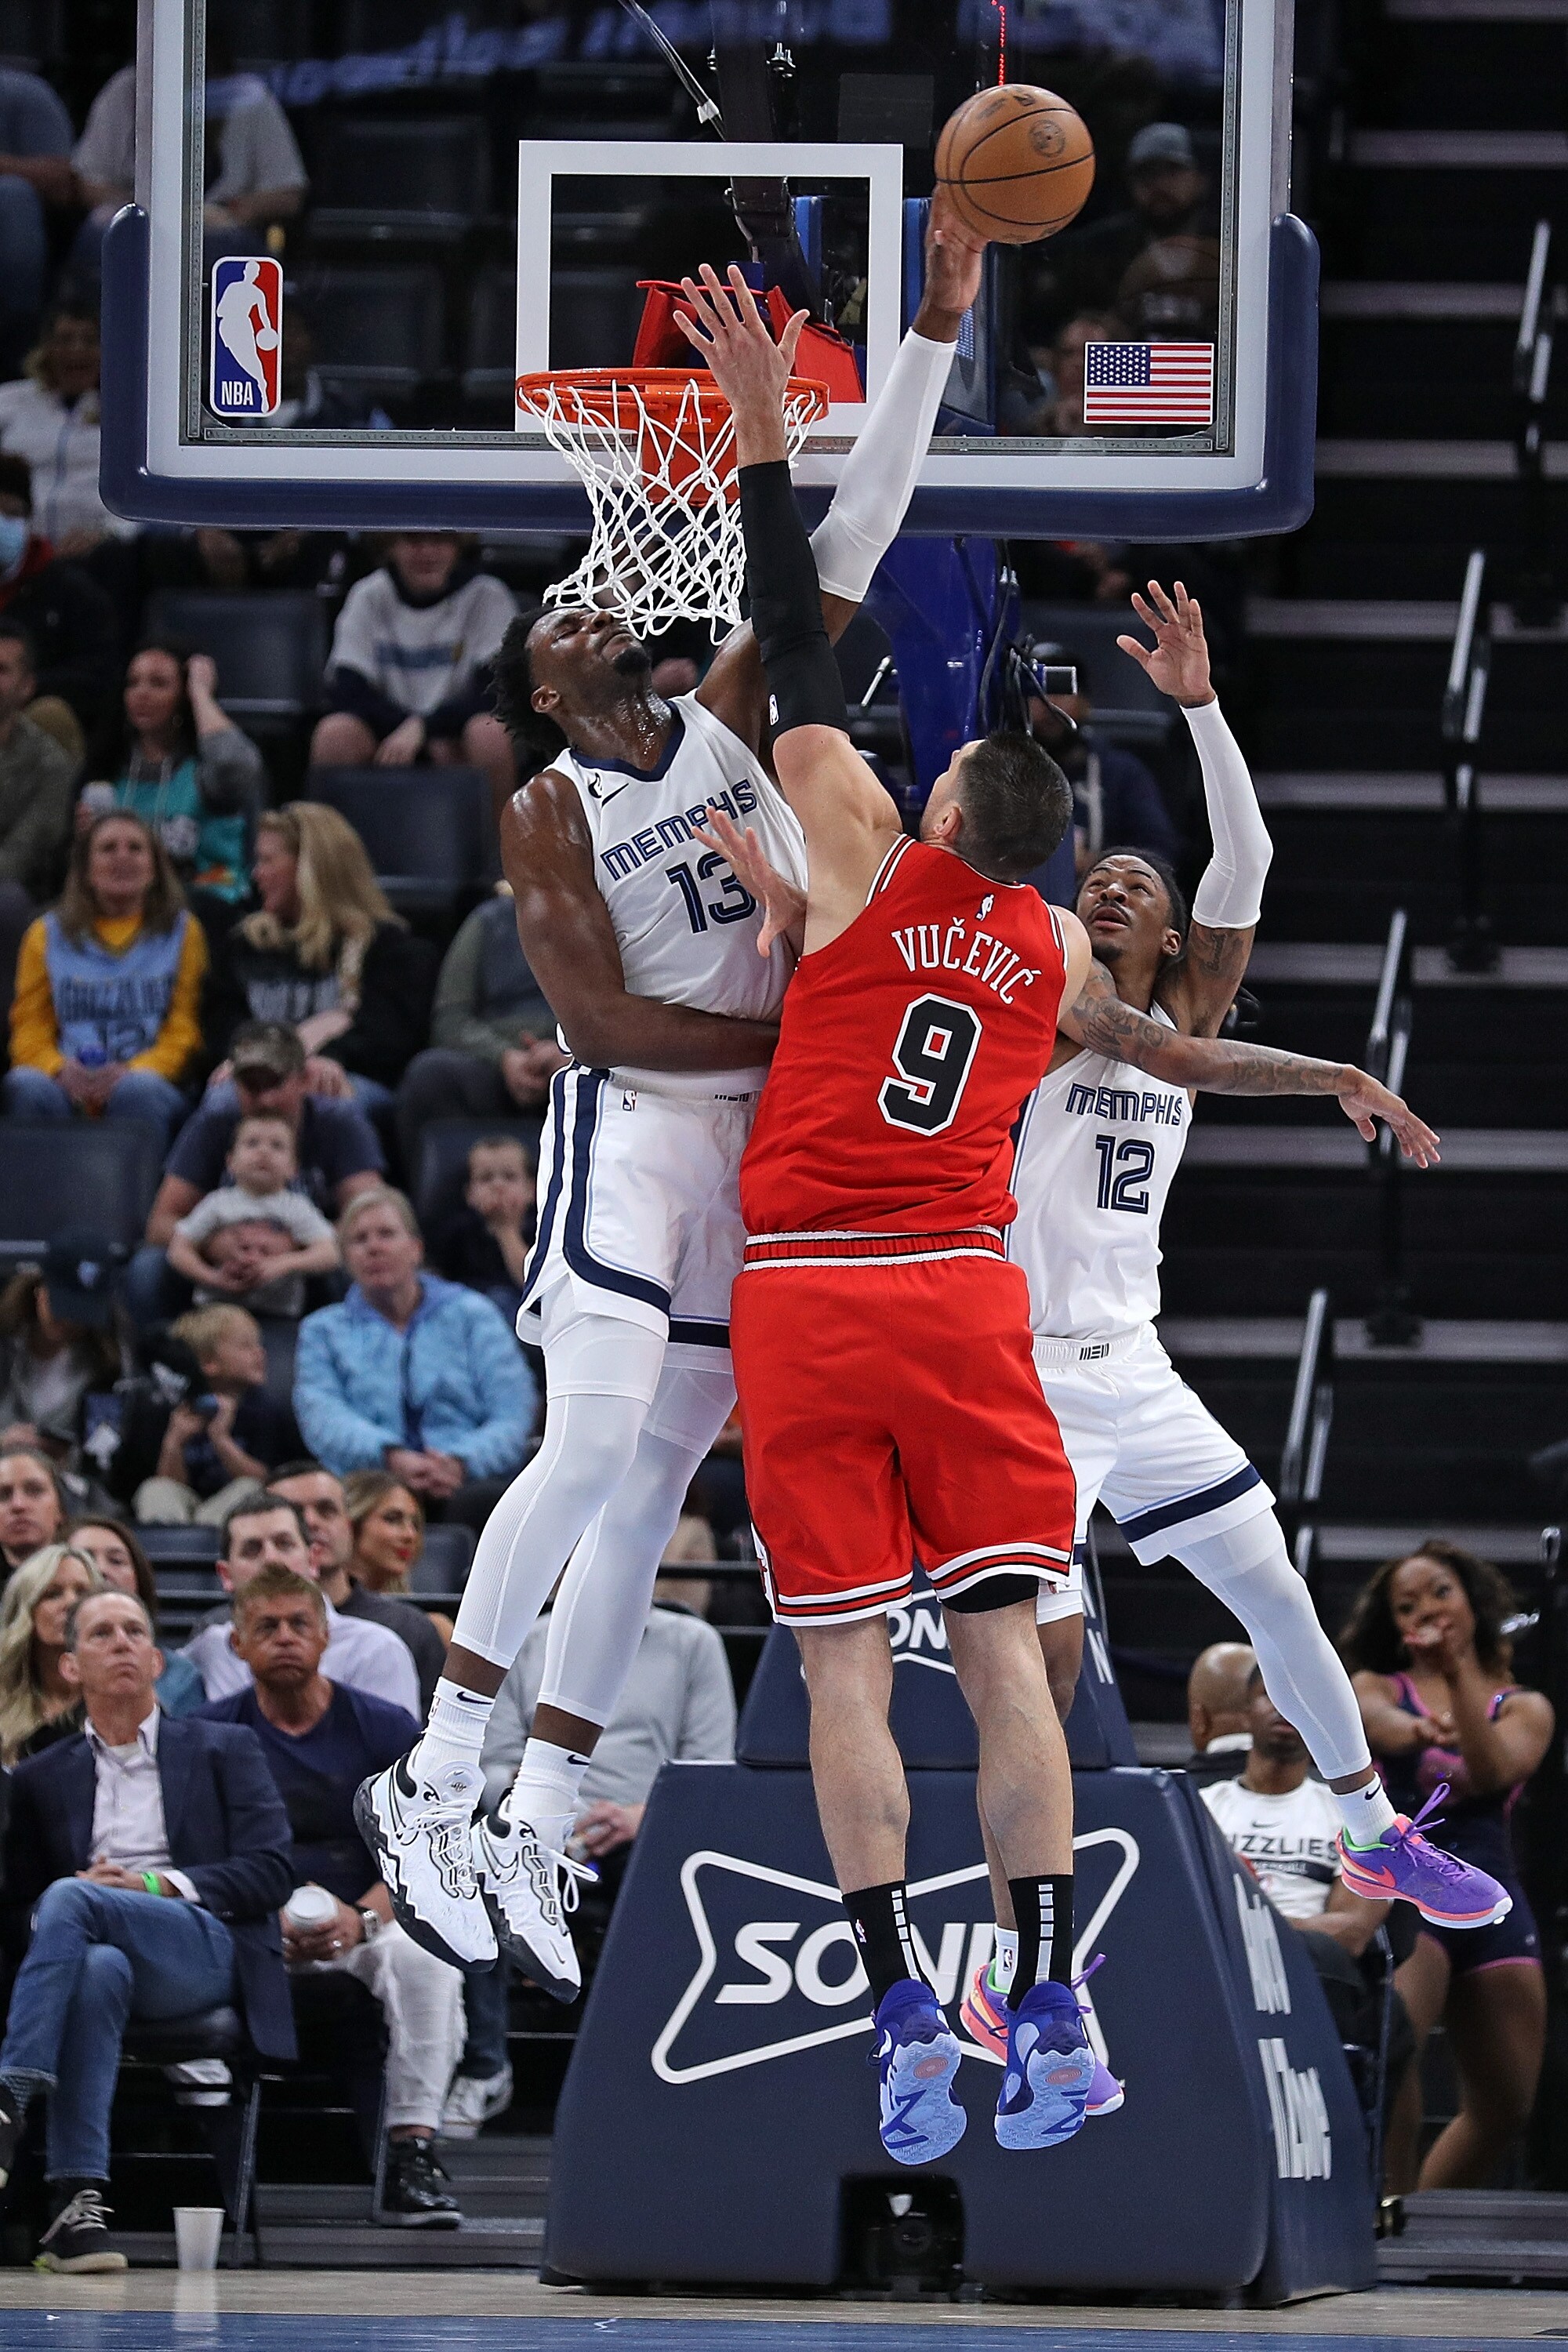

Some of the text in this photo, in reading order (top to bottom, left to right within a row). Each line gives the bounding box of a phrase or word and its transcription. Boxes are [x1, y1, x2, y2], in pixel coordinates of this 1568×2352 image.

[221, 380, 254, 405] NBA
[600, 779, 757, 881] MEMPHS
[665, 851, 757, 934] 13
[891, 916, 1041, 1004] VUČEVIĆ
[877, 993, 983, 1137] 9
[1065, 1083, 1182, 1126] MEMPHIS
[1095, 1134, 1155, 1214] 12
[1232, 1833, 1340, 1860] IZZLIES
[714, 1920, 996, 2006] SONI
